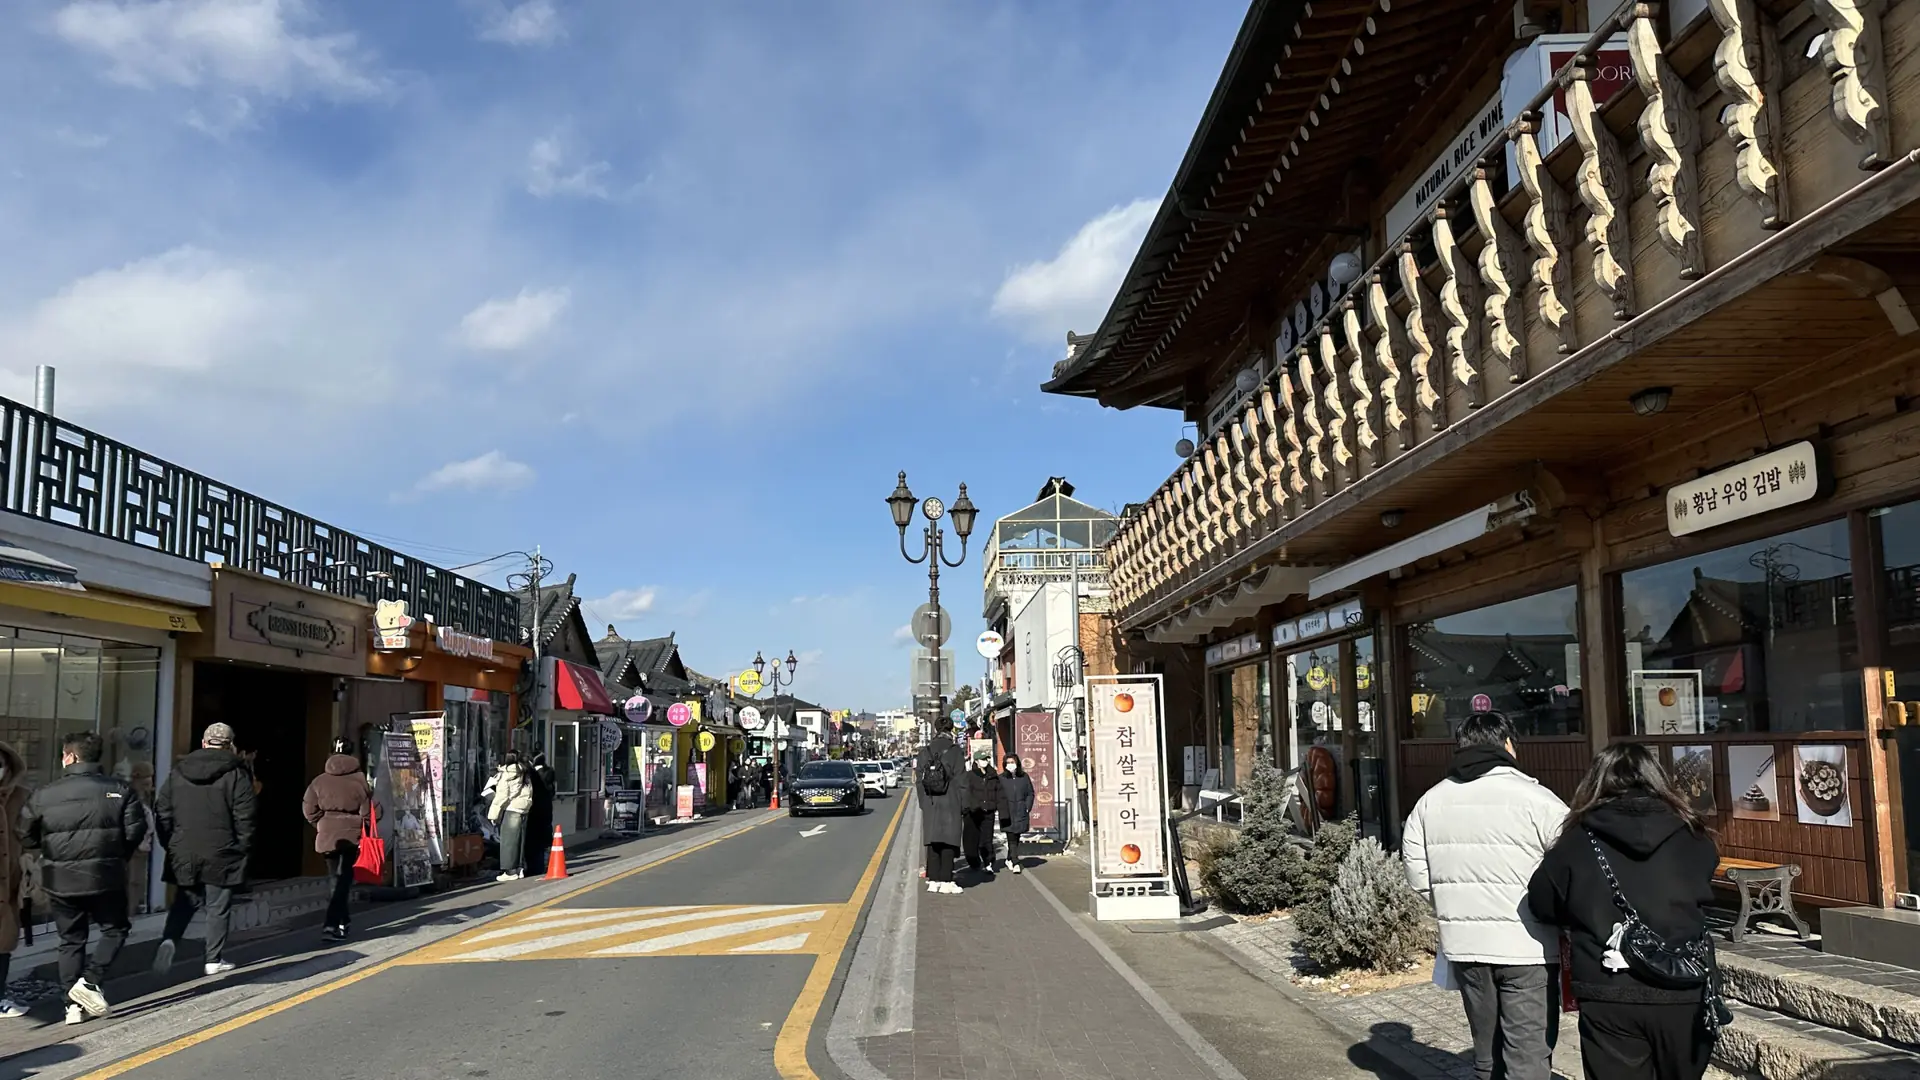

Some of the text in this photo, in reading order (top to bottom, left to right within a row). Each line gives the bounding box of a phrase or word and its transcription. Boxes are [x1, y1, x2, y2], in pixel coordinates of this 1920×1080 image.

[1415, 98, 1504, 210] NATURAL RICE WINE
[1692, 467, 1782, 516] 황남 우엉 김밥
[1020, 724, 1039, 734] GO
[1021, 732, 1050, 742] DORE
[1116, 725, 1140, 831] 찹쌀주악
